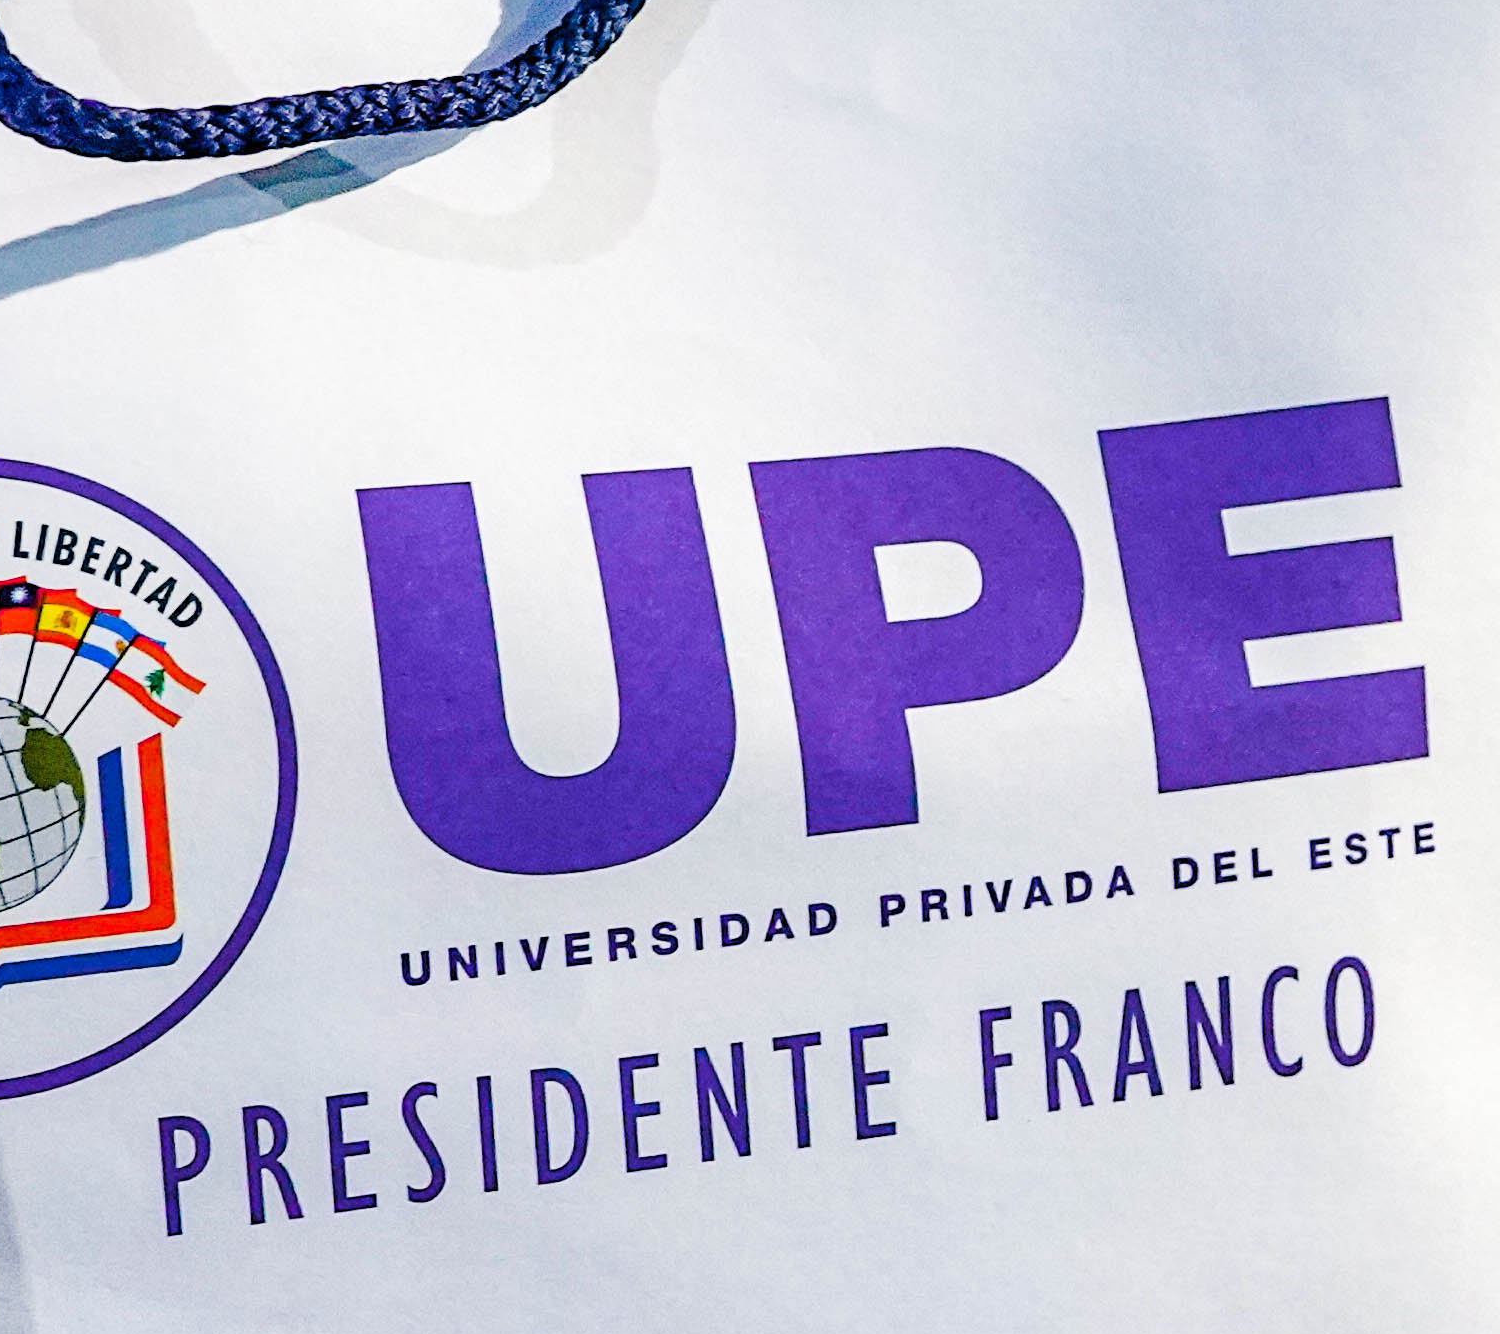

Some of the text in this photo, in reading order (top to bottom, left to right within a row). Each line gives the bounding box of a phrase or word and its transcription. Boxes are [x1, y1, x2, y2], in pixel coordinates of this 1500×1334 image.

[12, 521, 204, 628] LIBERTAD
[355, 395, 1431, 876] UPE
[400, 822, 1437, 986] UNIVERSIDAD PRIVADA DEL ESTE
[156, 955, 1377, 1238] PRESIDENTE FRANCO
